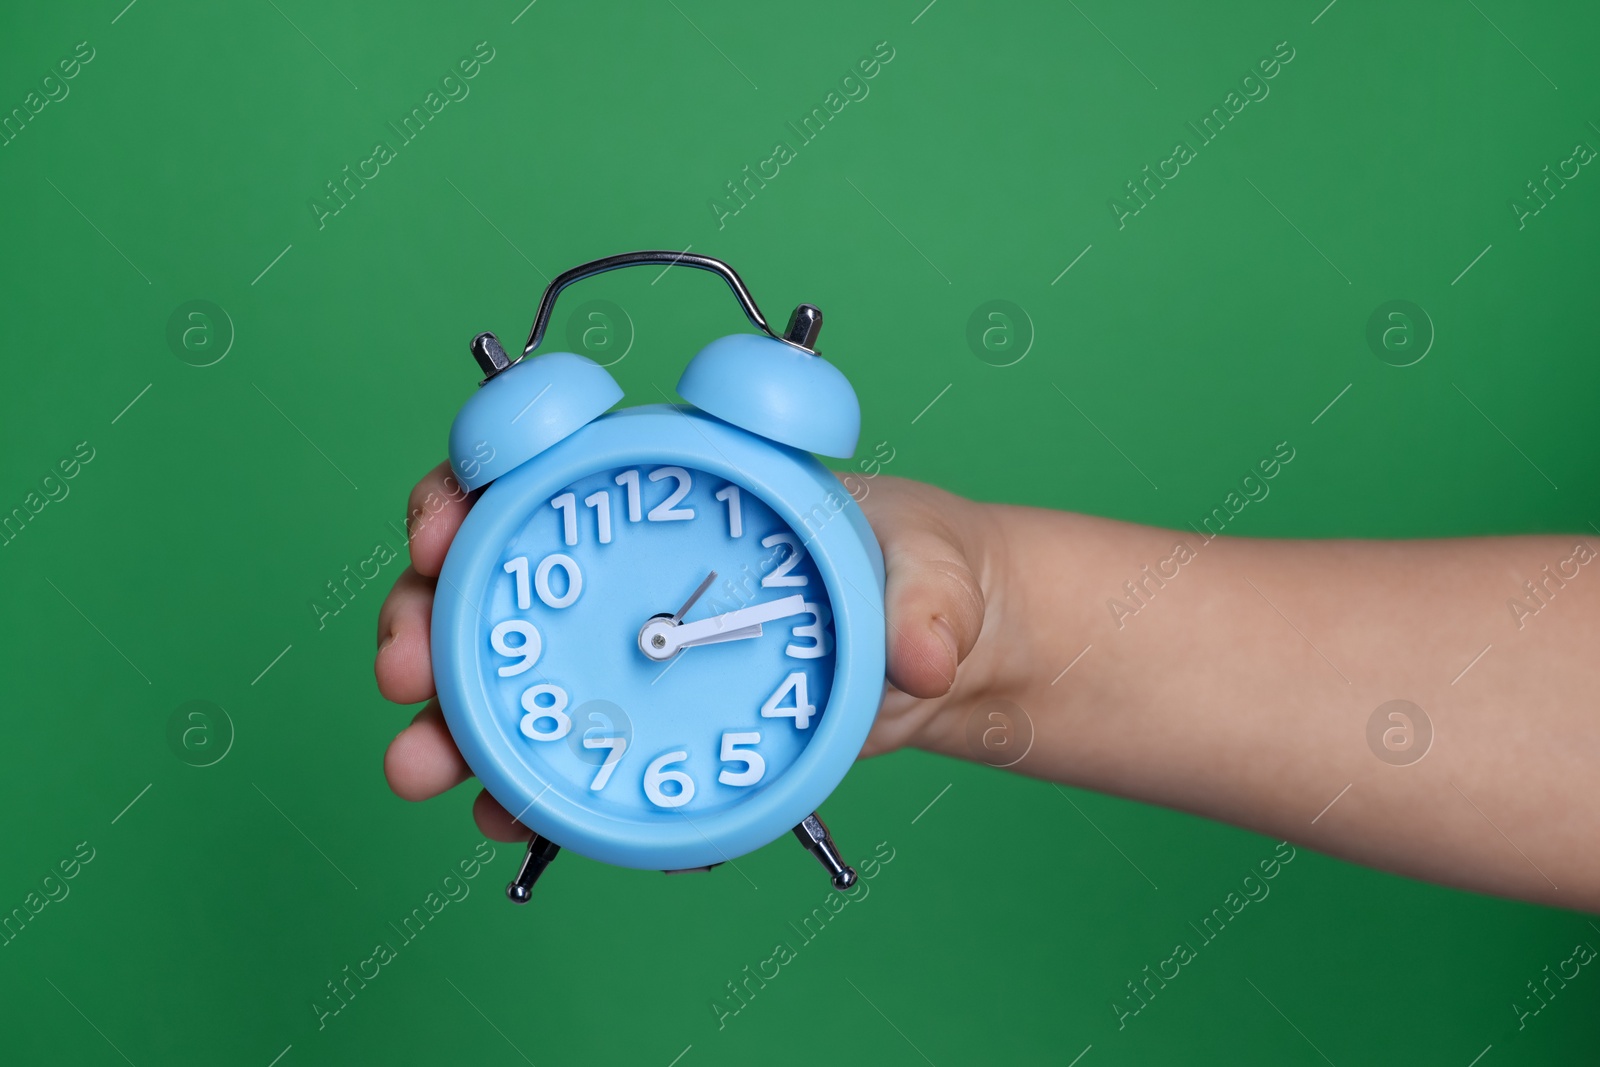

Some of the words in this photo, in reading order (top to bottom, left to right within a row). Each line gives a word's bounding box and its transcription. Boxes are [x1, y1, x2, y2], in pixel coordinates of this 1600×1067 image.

[551, 491, 612, 545] 11
[615, 467, 695, 522] 12
[715, 486, 743, 538] 1
[503, 554, 582, 609] 10
[761, 533, 808, 587] 2
[490, 620, 542, 677] 9
[785, 602, 830, 659] 3
[520, 683, 572, 741] 8
[761, 672, 816, 729] 4
[583, 737, 627, 790] 7
[643, 751, 695, 808] 6
[718, 732, 765, 787] 5
